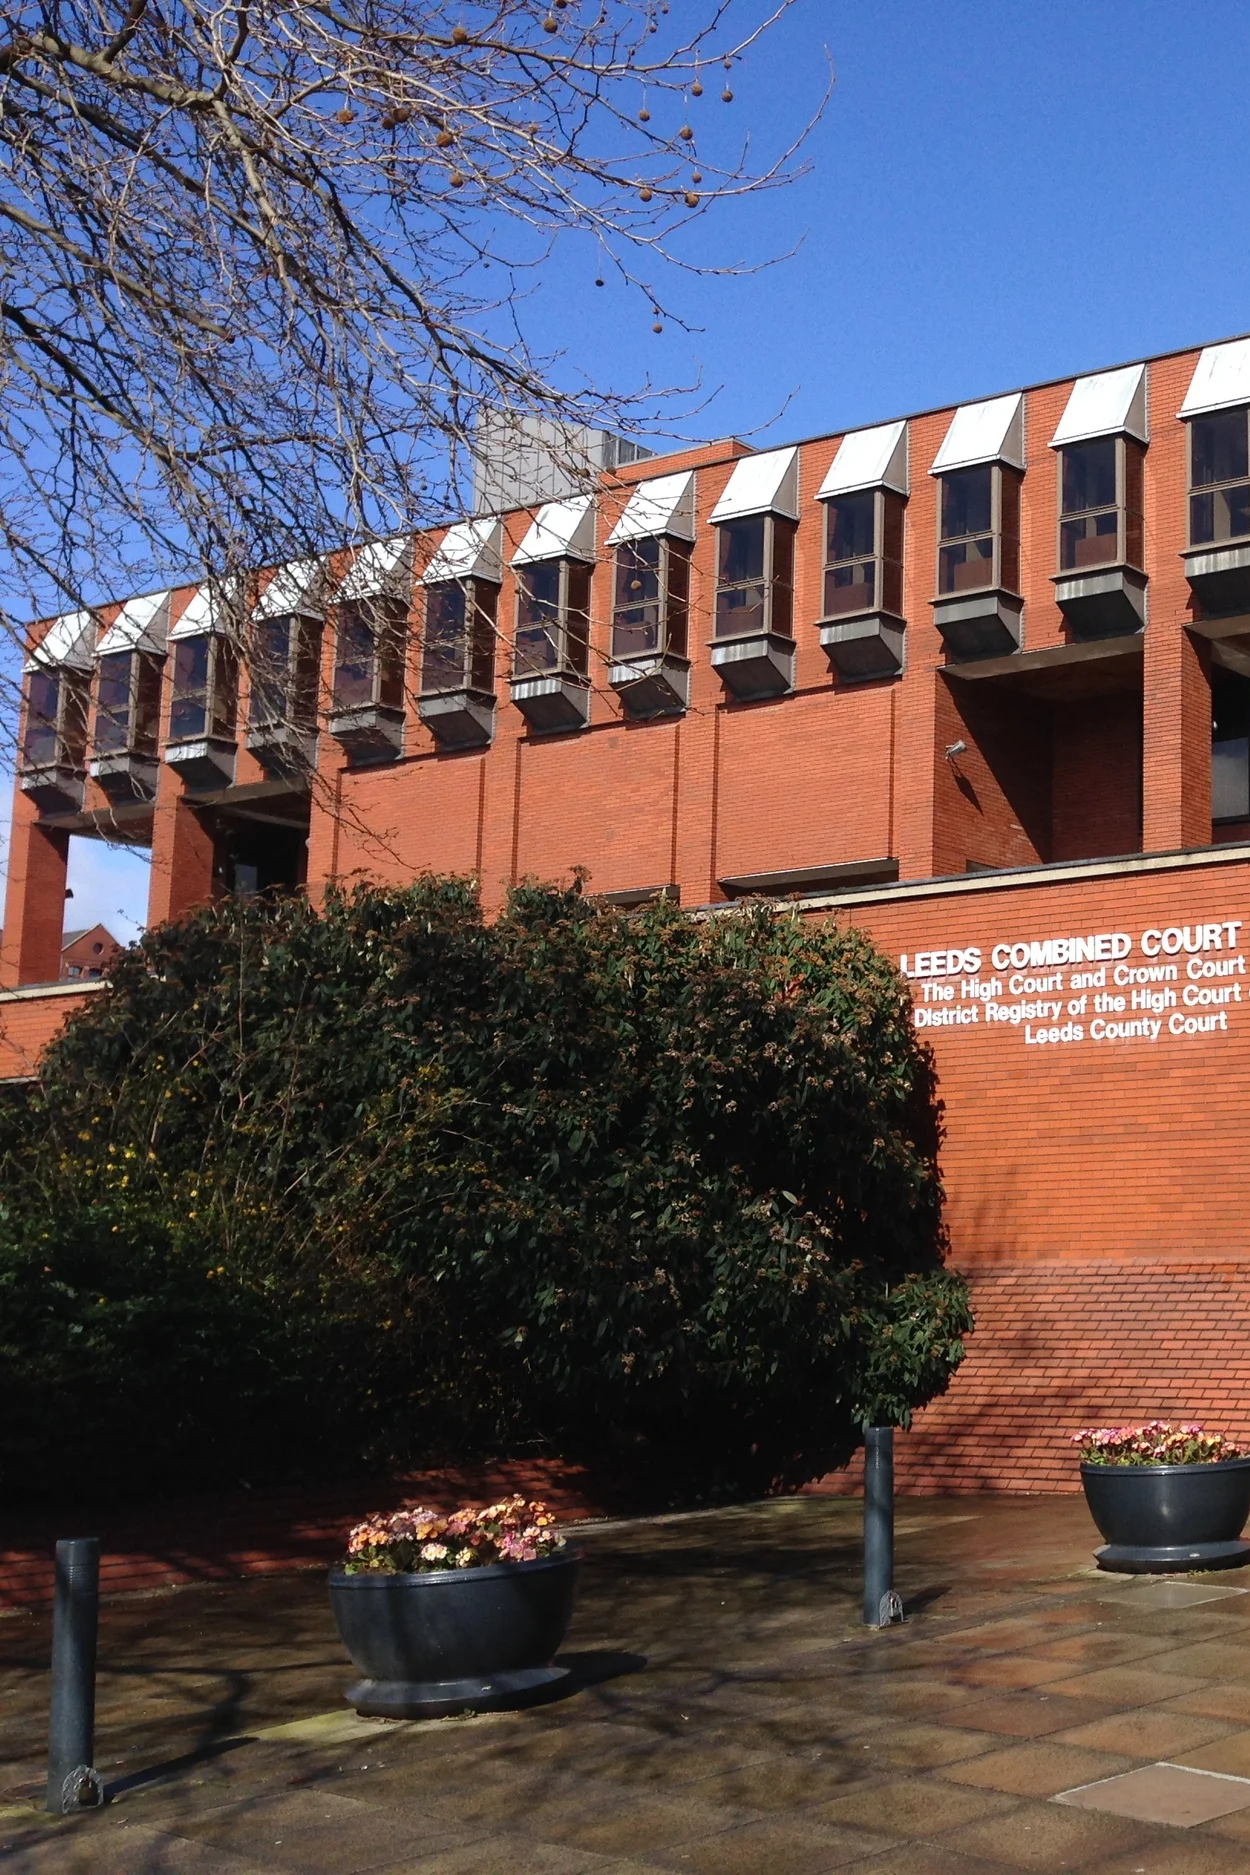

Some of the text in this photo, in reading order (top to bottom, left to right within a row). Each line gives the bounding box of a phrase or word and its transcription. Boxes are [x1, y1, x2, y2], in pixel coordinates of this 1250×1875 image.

[900, 947, 982, 978] LEEDS
[991, 933, 1132, 971] COMBINED
[1141, 921, 1242, 957] COURT
[921, 983, 954, 1003] The
[961, 976, 1003, 1002] High
[1008, 972, 1063, 996] Court
[1070, 968, 1106, 989] and
[1113, 964, 1178, 987] Crown
[1186, 954, 1246, 980] Court
[914, 1004, 979, 1028] District
[985, 1000, 1062, 1025] Registry
[1067, 994, 1087, 1016] of
[1094, 991, 1126, 1013] the
[1131, 986, 1177, 1014] High
[1182, 981, 1242, 1007] Court
[1025, 1010, 1228, 1045] Leeds County Court
